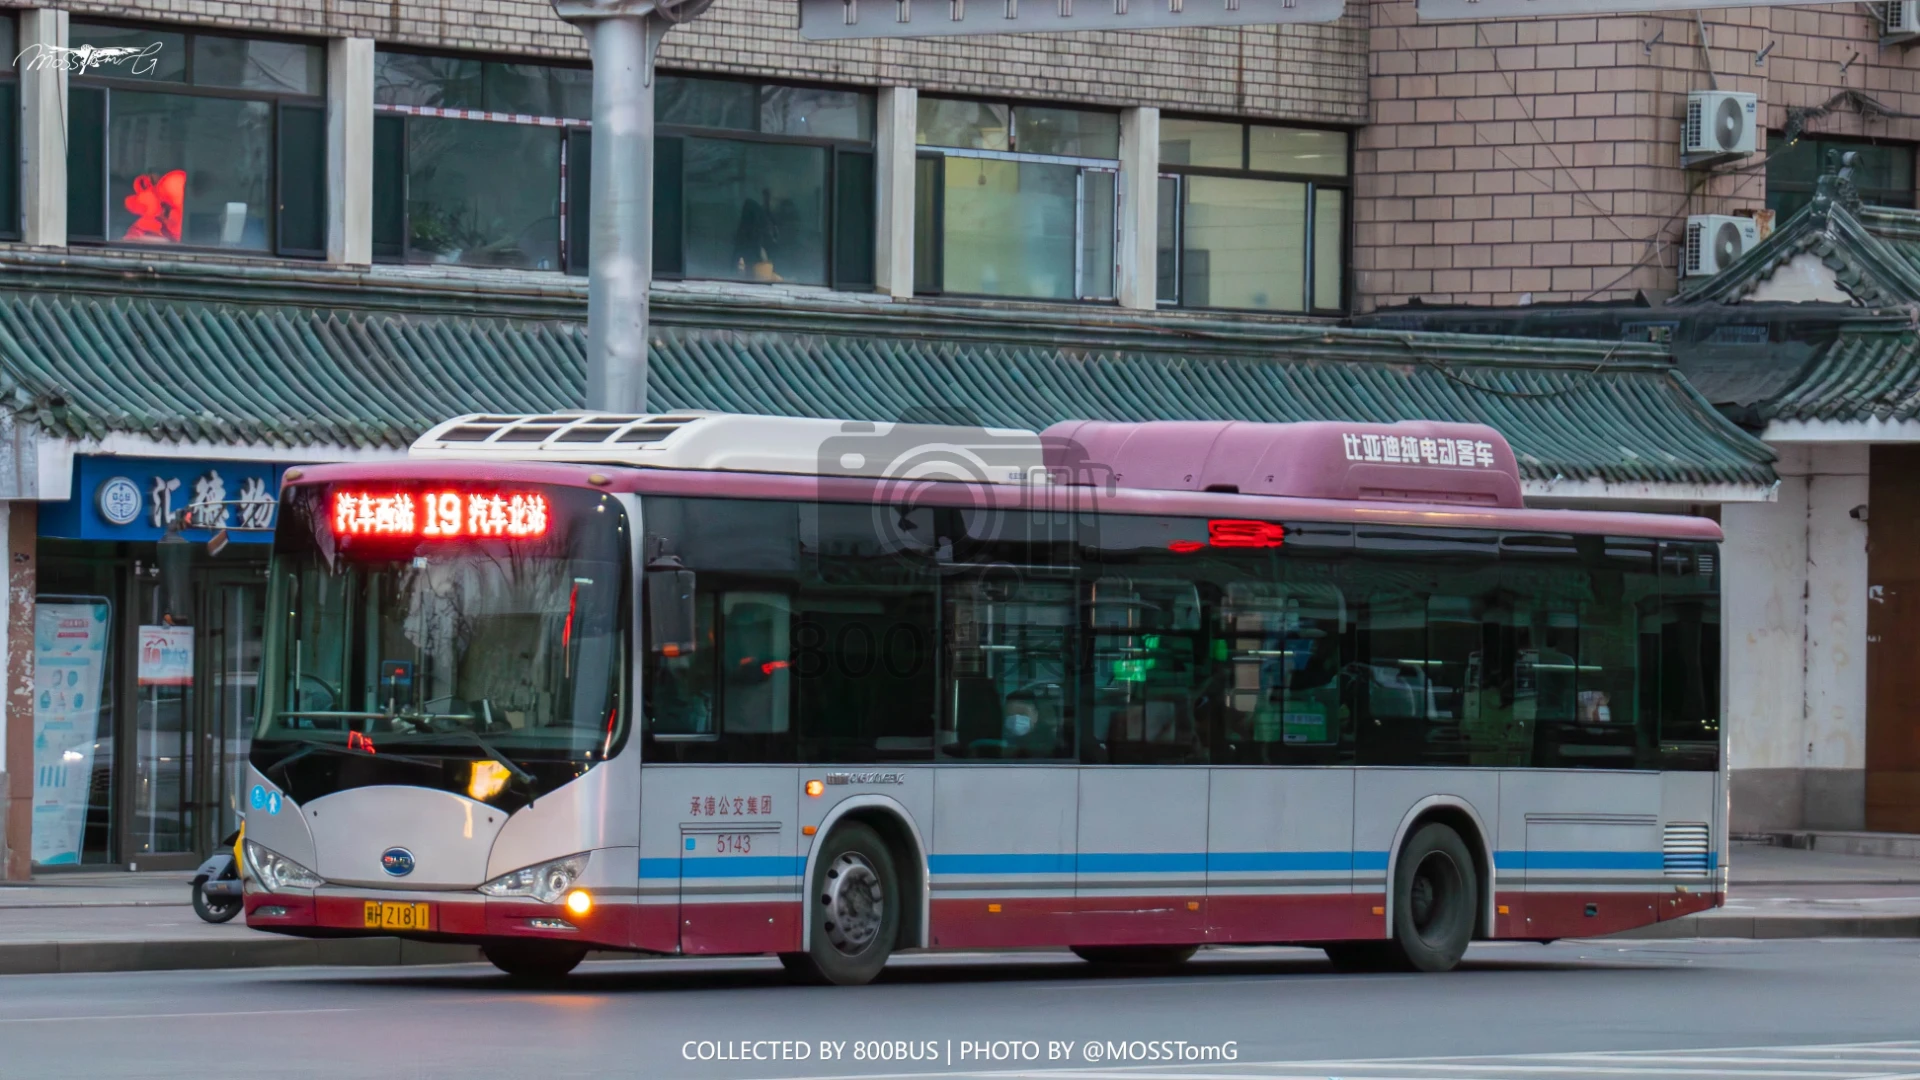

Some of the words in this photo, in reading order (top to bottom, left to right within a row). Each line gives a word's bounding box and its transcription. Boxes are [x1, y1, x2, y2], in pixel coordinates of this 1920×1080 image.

[1342, 432, 1495, 468] 比亚迪纯电动客车
[335, 492, 415, 534] 汽车西站
[422, 492, 462, 536] 19
[468, 493, 547, 537] 汽车北站
[690, 795, 773, 817] 承德公交集团
[717, 834, 752, 854] 5143
